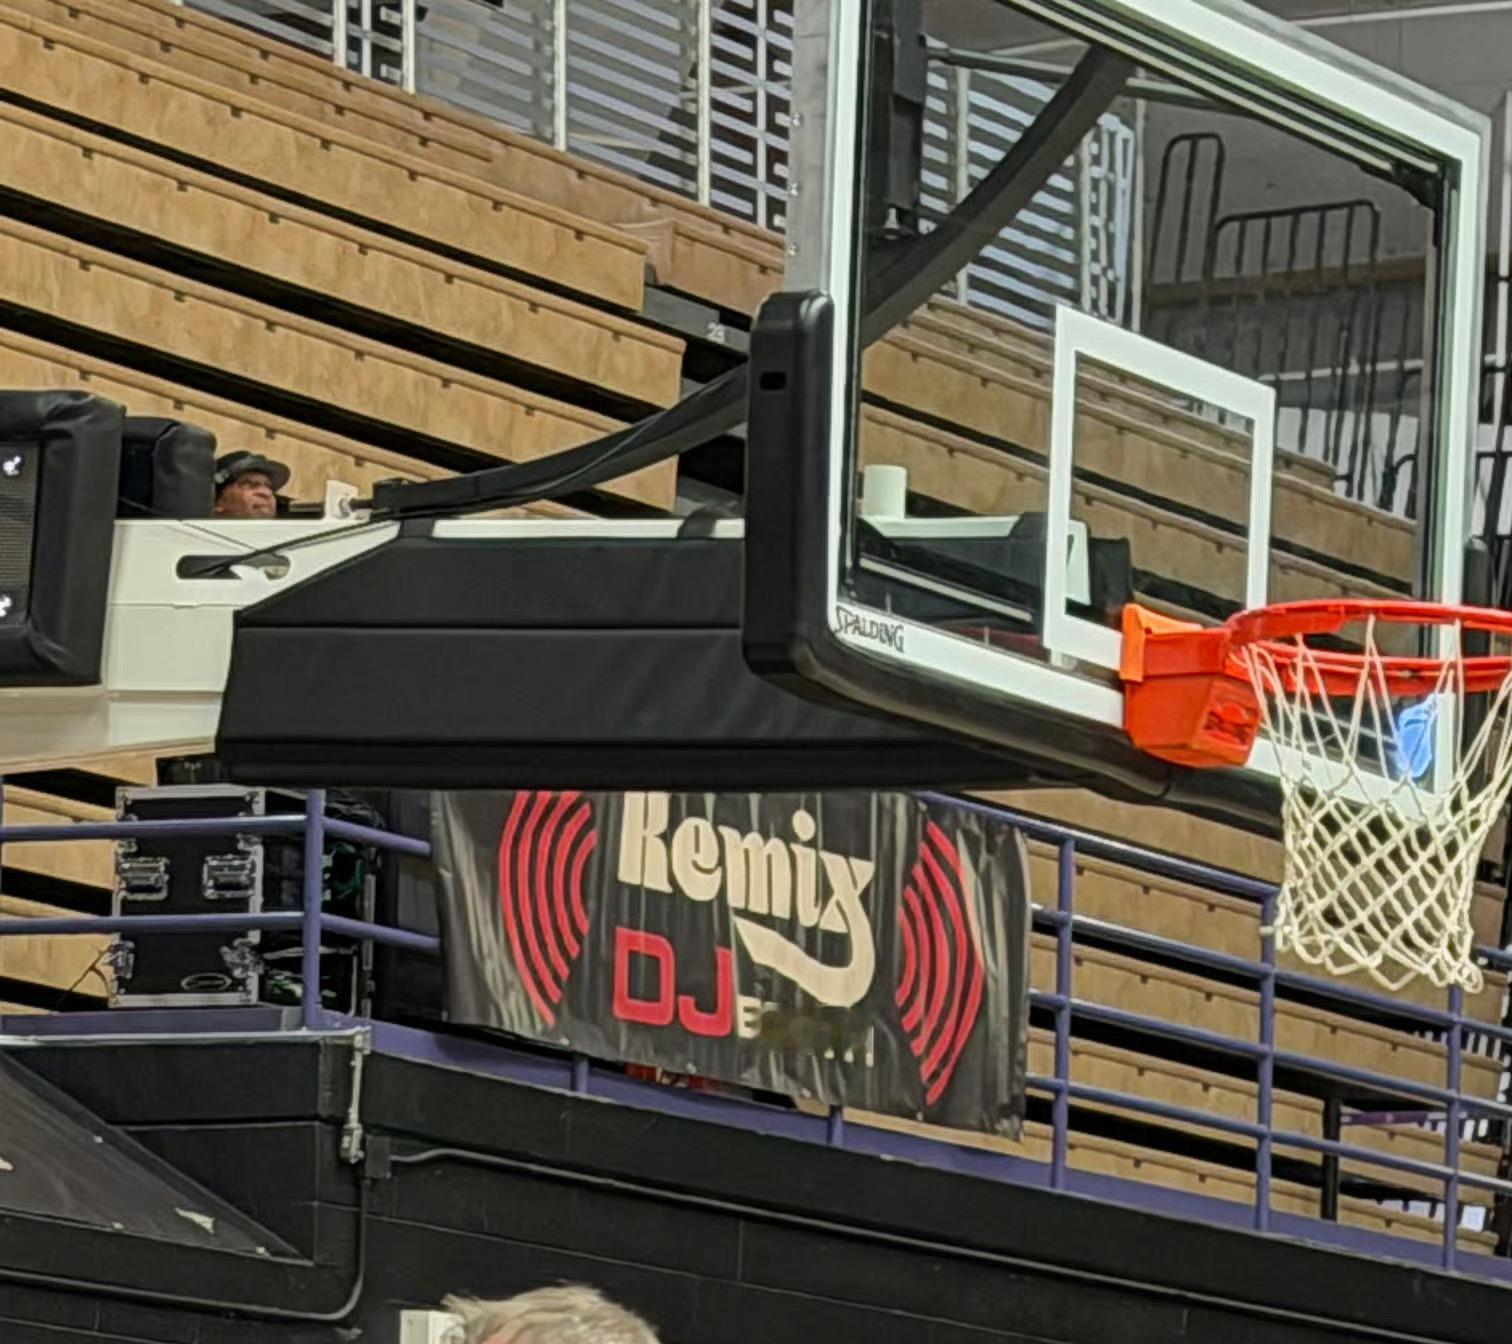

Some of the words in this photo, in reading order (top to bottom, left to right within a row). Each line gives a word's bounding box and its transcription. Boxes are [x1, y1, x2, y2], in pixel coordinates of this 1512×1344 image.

[834, 604, 905, 653] SPALDING
[617, 791, 875, 1008] Remix
[612, 926, 734, 1038] DJ
